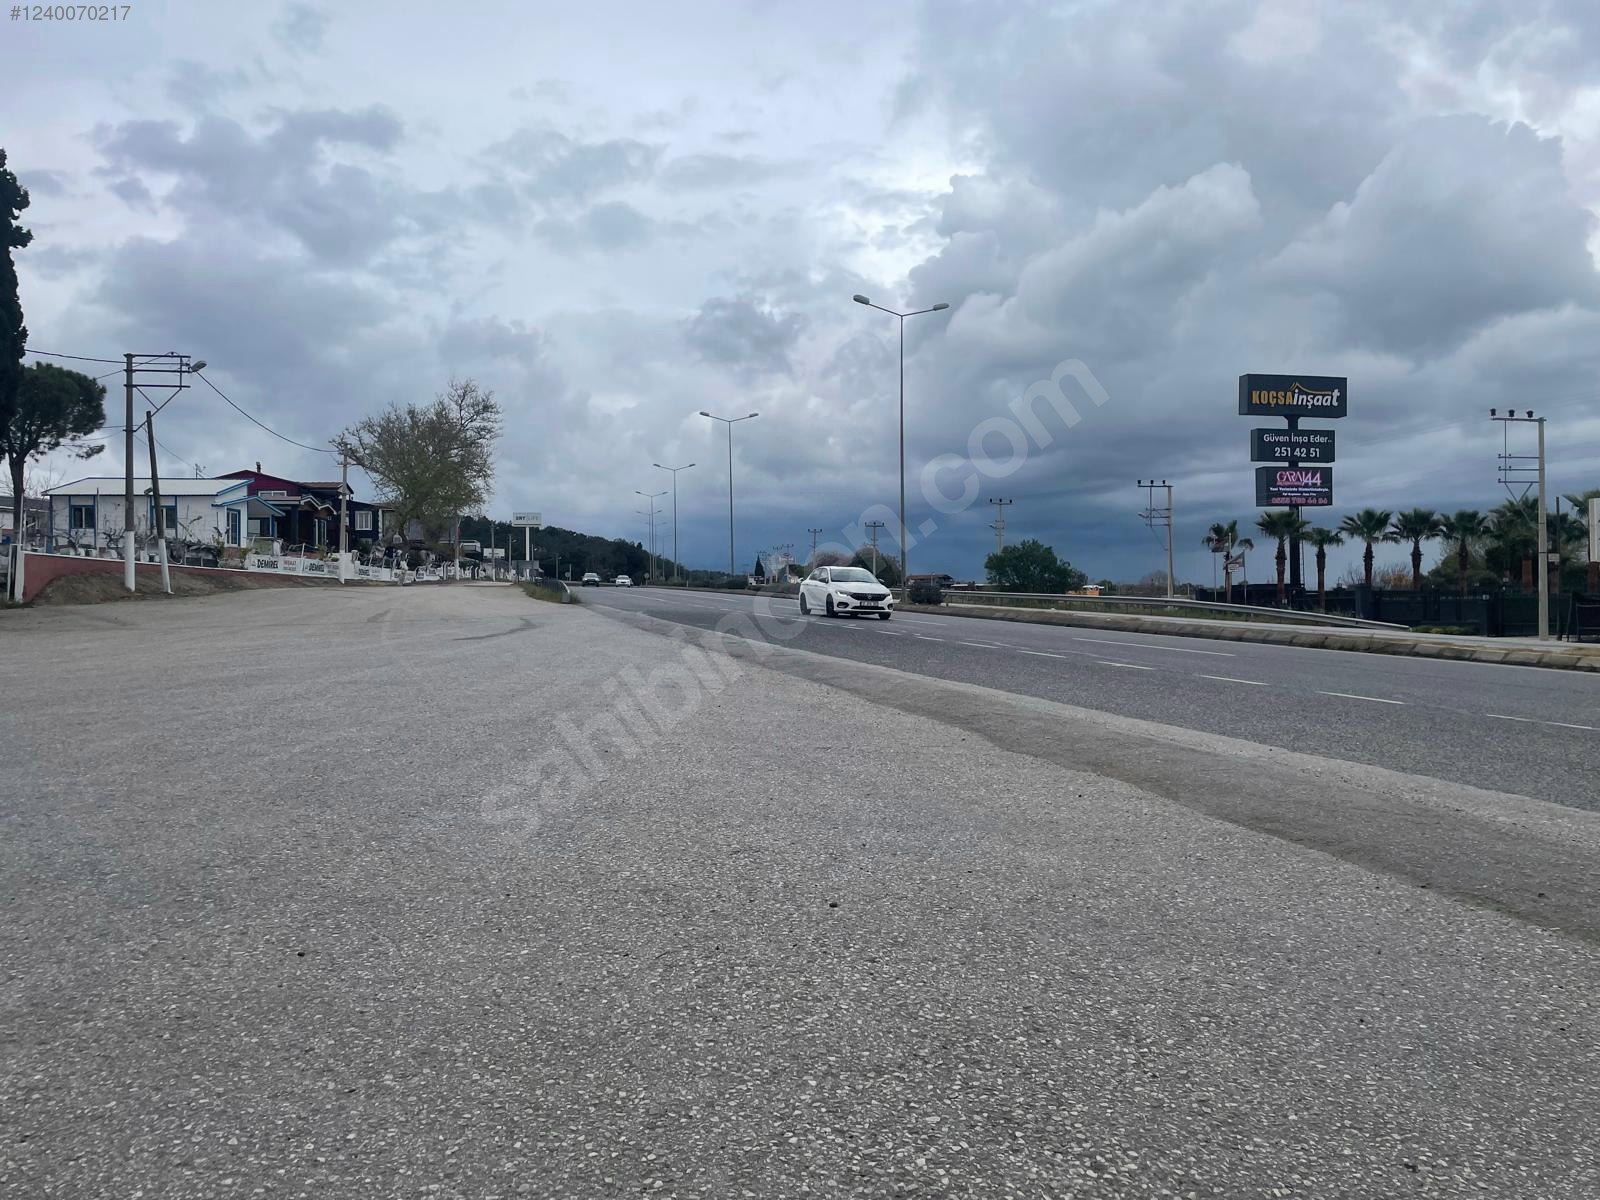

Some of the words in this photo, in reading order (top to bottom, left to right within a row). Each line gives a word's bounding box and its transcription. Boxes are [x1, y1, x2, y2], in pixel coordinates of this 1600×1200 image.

[1263, 433, 1290, 442] Güven
[1274, 447, 1291, 457] 251
[1293, 448, 1307, 457] 42
[1309, 448, 1320, 458] 51
